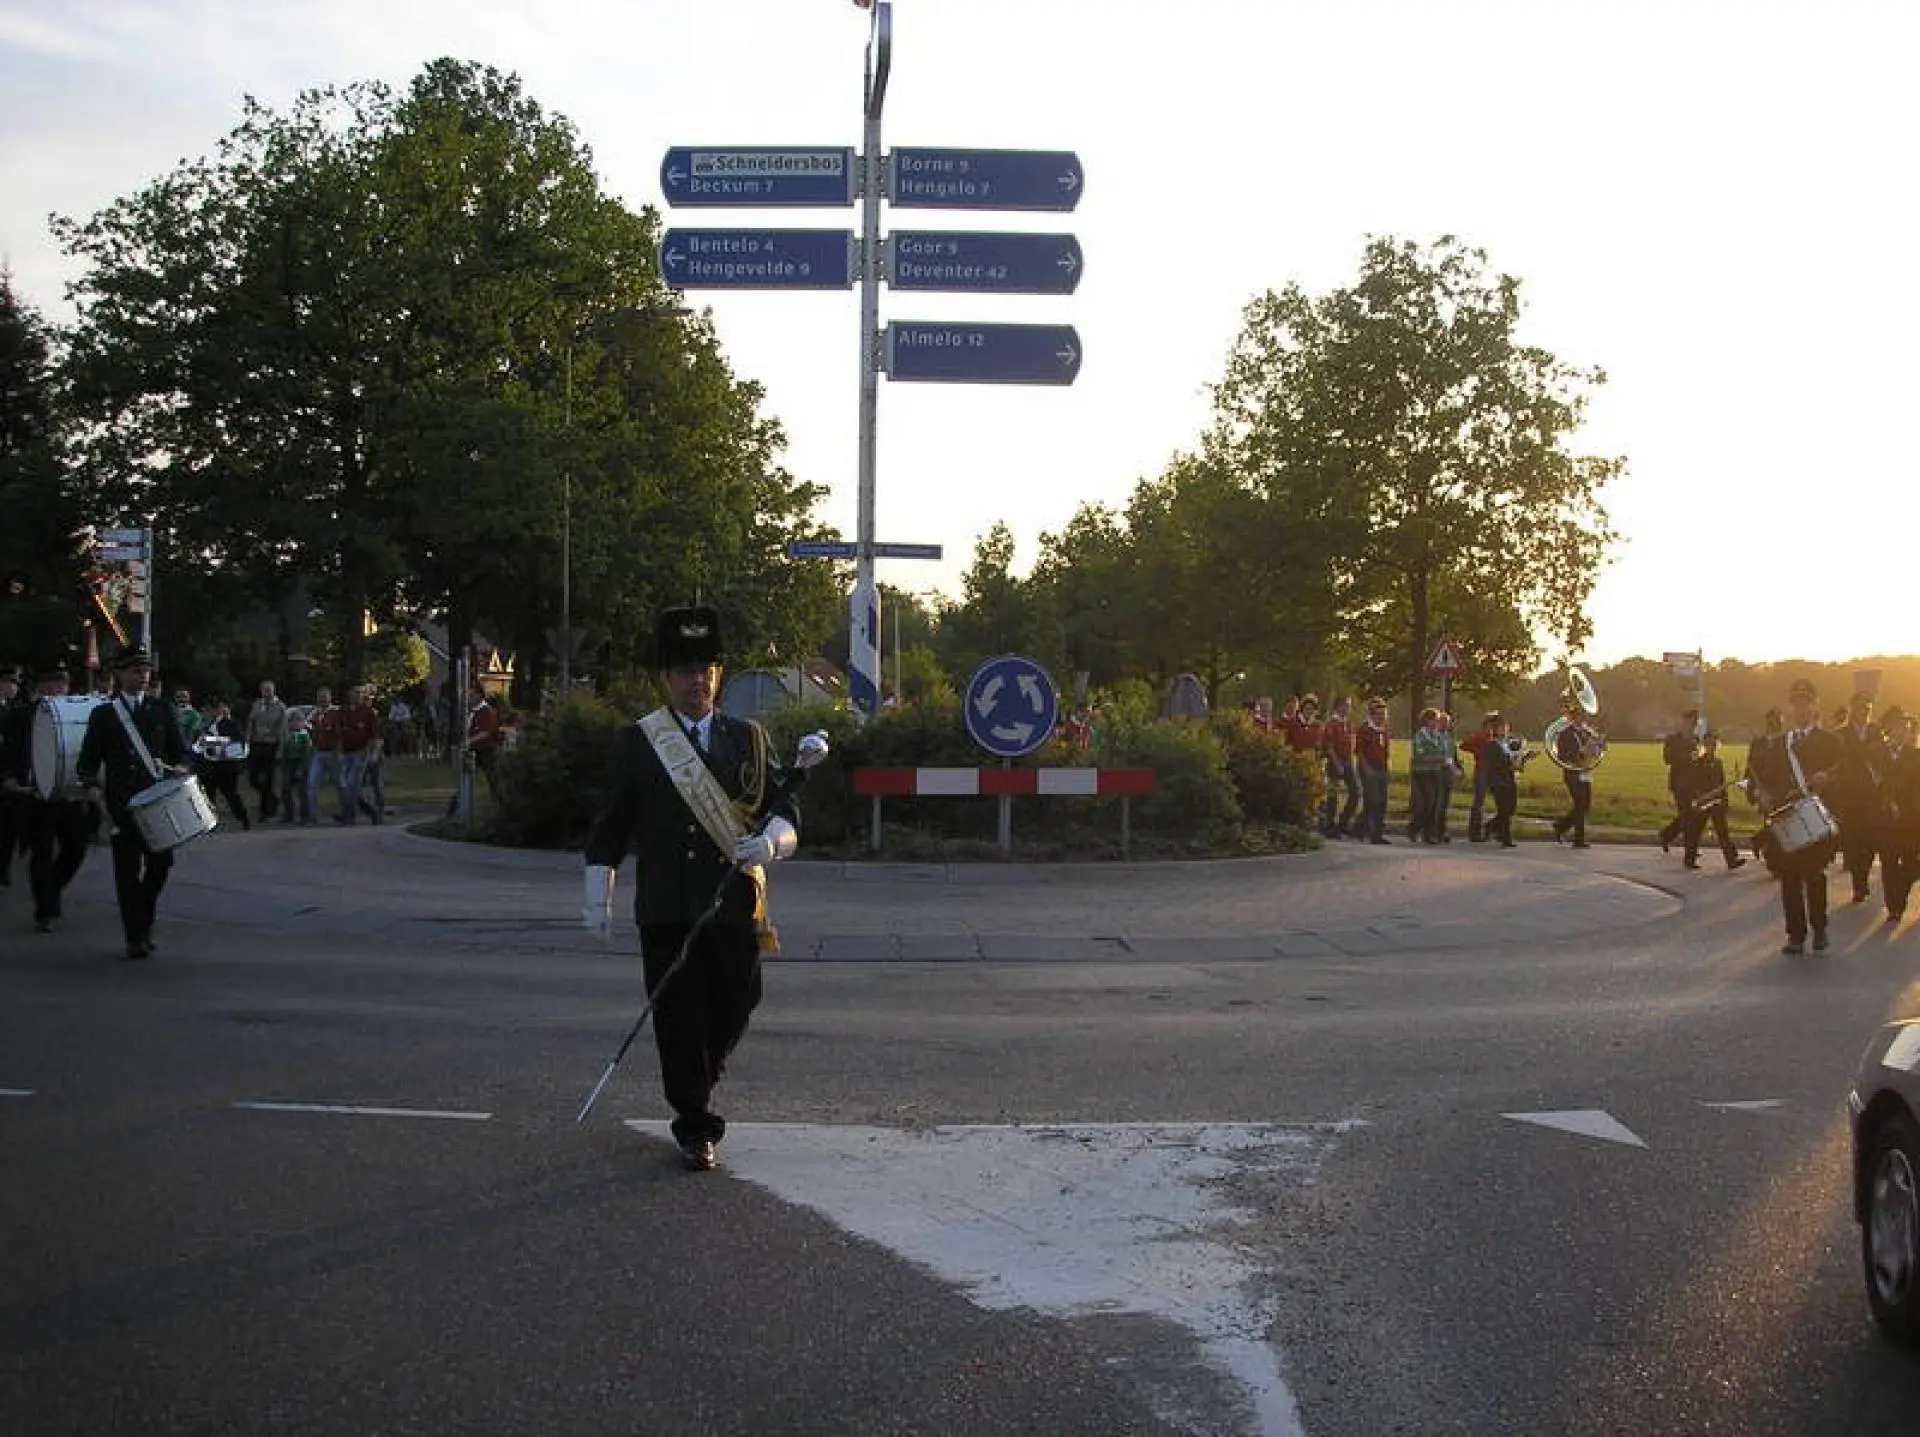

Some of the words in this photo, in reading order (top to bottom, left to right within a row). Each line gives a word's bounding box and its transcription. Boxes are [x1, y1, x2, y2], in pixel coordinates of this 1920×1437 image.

[902, 156, 953, 171] Borne
[691, 180, 759, 193] Beckum
[765, 180, 773, 193] 7
[902, 180, 975, 197] Hengelo
[690, 237, 758, 252] Bentelo
[764, 238, 773, 251] 4
[900, 240, 942, 253] Goor
[690, 261, 794, 279] Hengevelde
[900, 264, 984, 277] Deventer
[990, 266, 1006, 277] 42
[899, 330, 961, 346] Almelo
[969, 334, 984, 346] 12
